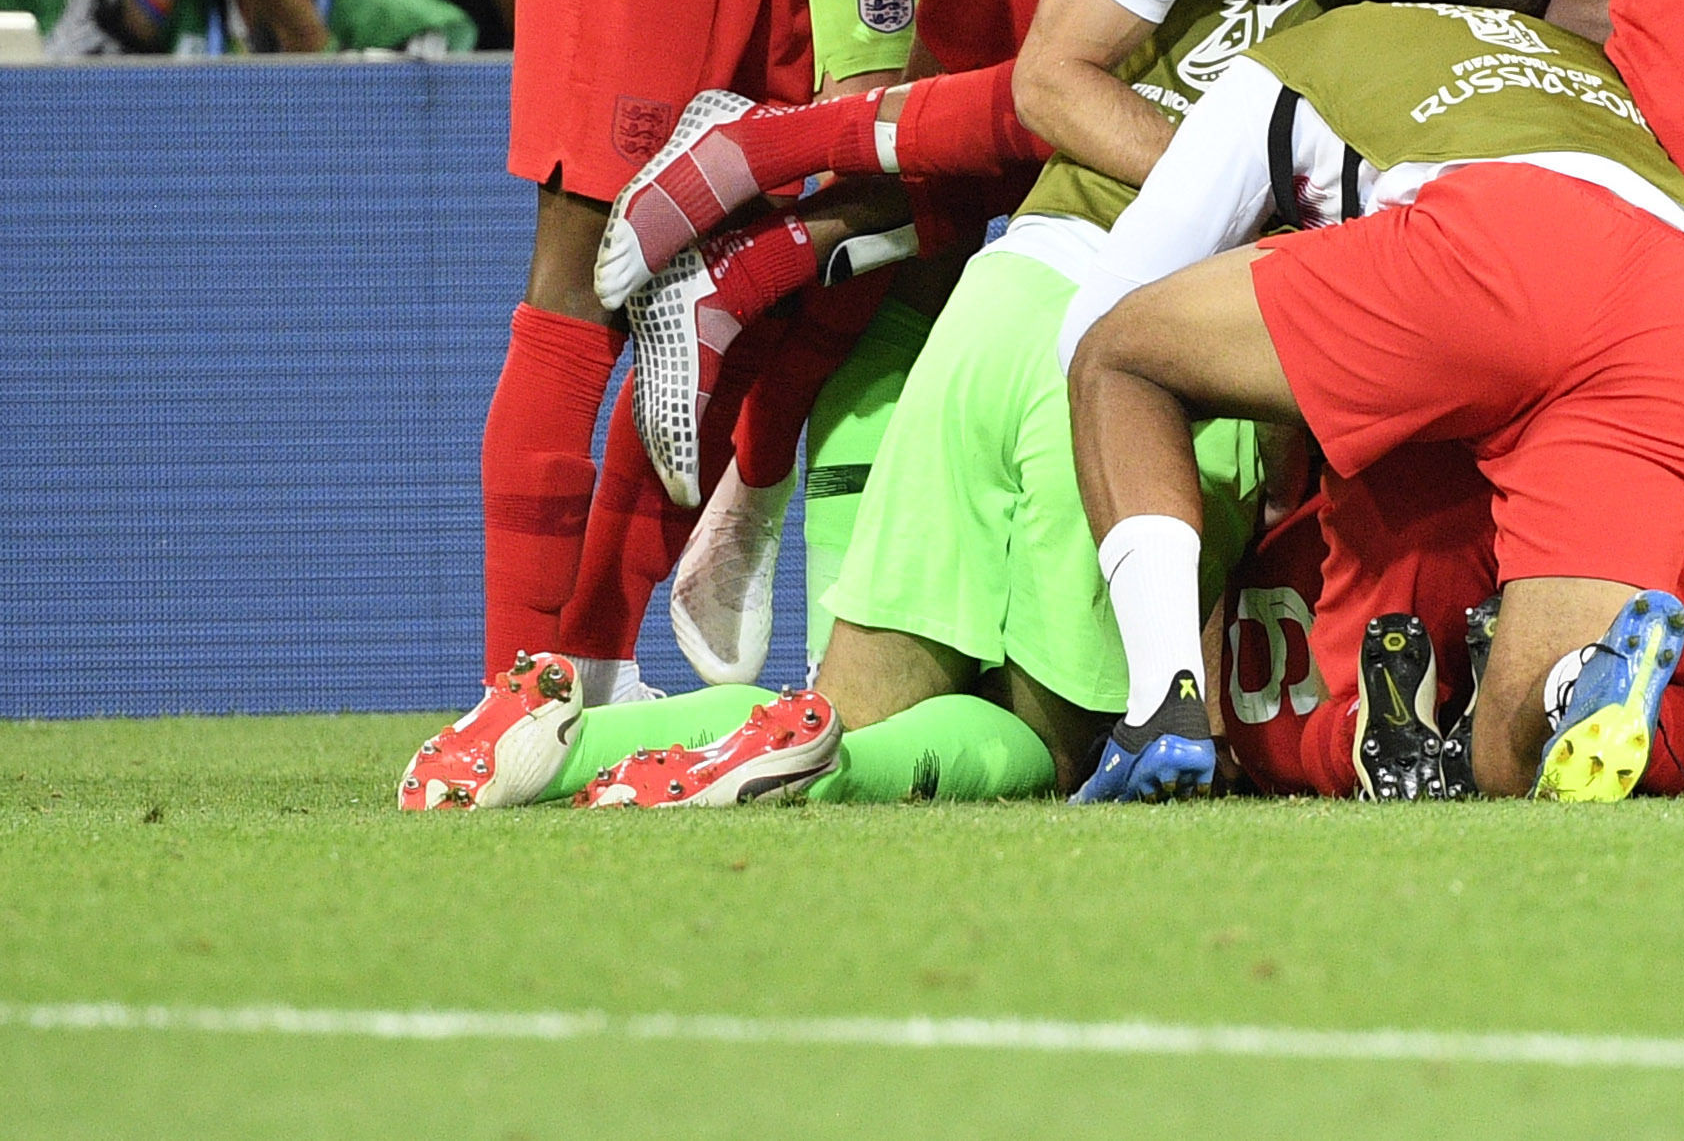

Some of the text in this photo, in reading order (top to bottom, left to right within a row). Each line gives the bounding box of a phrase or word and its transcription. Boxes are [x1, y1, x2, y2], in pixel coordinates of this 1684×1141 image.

[1451, 53, 1604, 89] FIFA WORLD CUP
[1410, 66, 1576, 124] RUSSIA
